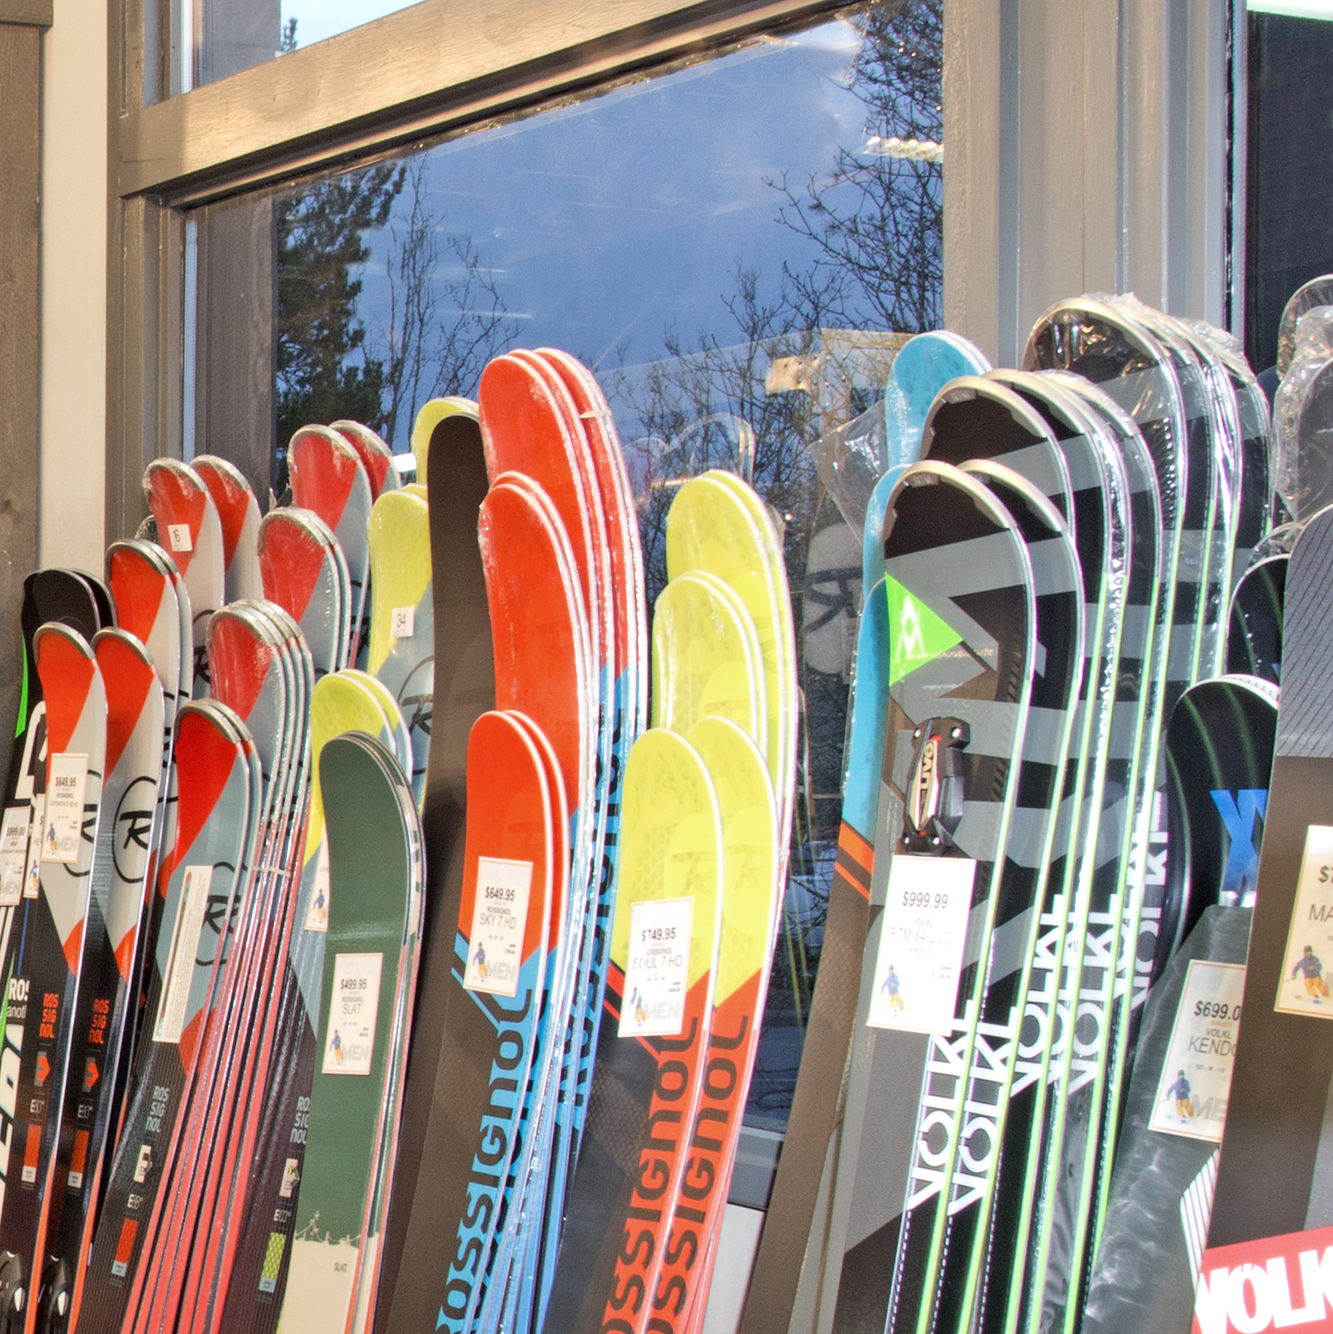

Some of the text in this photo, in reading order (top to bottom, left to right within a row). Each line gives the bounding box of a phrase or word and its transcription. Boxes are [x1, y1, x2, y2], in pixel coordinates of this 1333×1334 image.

[396, 612, 407, 628] 34
[485, 886, 515, 902] $649.95
[902, 890, 949, 909] $999.99
[479, 912, 495, 926] SKY
[504, 916, 517, 930] HD
[642, 927, 676, 942] $749.95
[669, 954, 683, 968] HD
[486, 959, 516, 983] MEN
[340, 978, 368, 990] $499.95
[43, 993, 59, 1008] ROS
[1009, 893, 1066, 1098] VOLKL
[1067, 893, 1118, 1097] VOLKL
[94, 998, 110, 1014] ROS
[342, 1003, 362, 1015] SLAT
[644, 1001, 680, 1020] MEN
[42, 1008, 58, 1023] SIG
[92, 1014, 107, 1028] SIG
[1205, 1027, 1232, 1040] VOLKL
[342, 1044, 369, 1061] MEN
[152, 1085, 169, 1102] ROS
[150, 1101, 165, 1117] SIG
[947, 1005, 1018, 1216] VOLKL
[334, 1262, 348, 1273] SLAT
